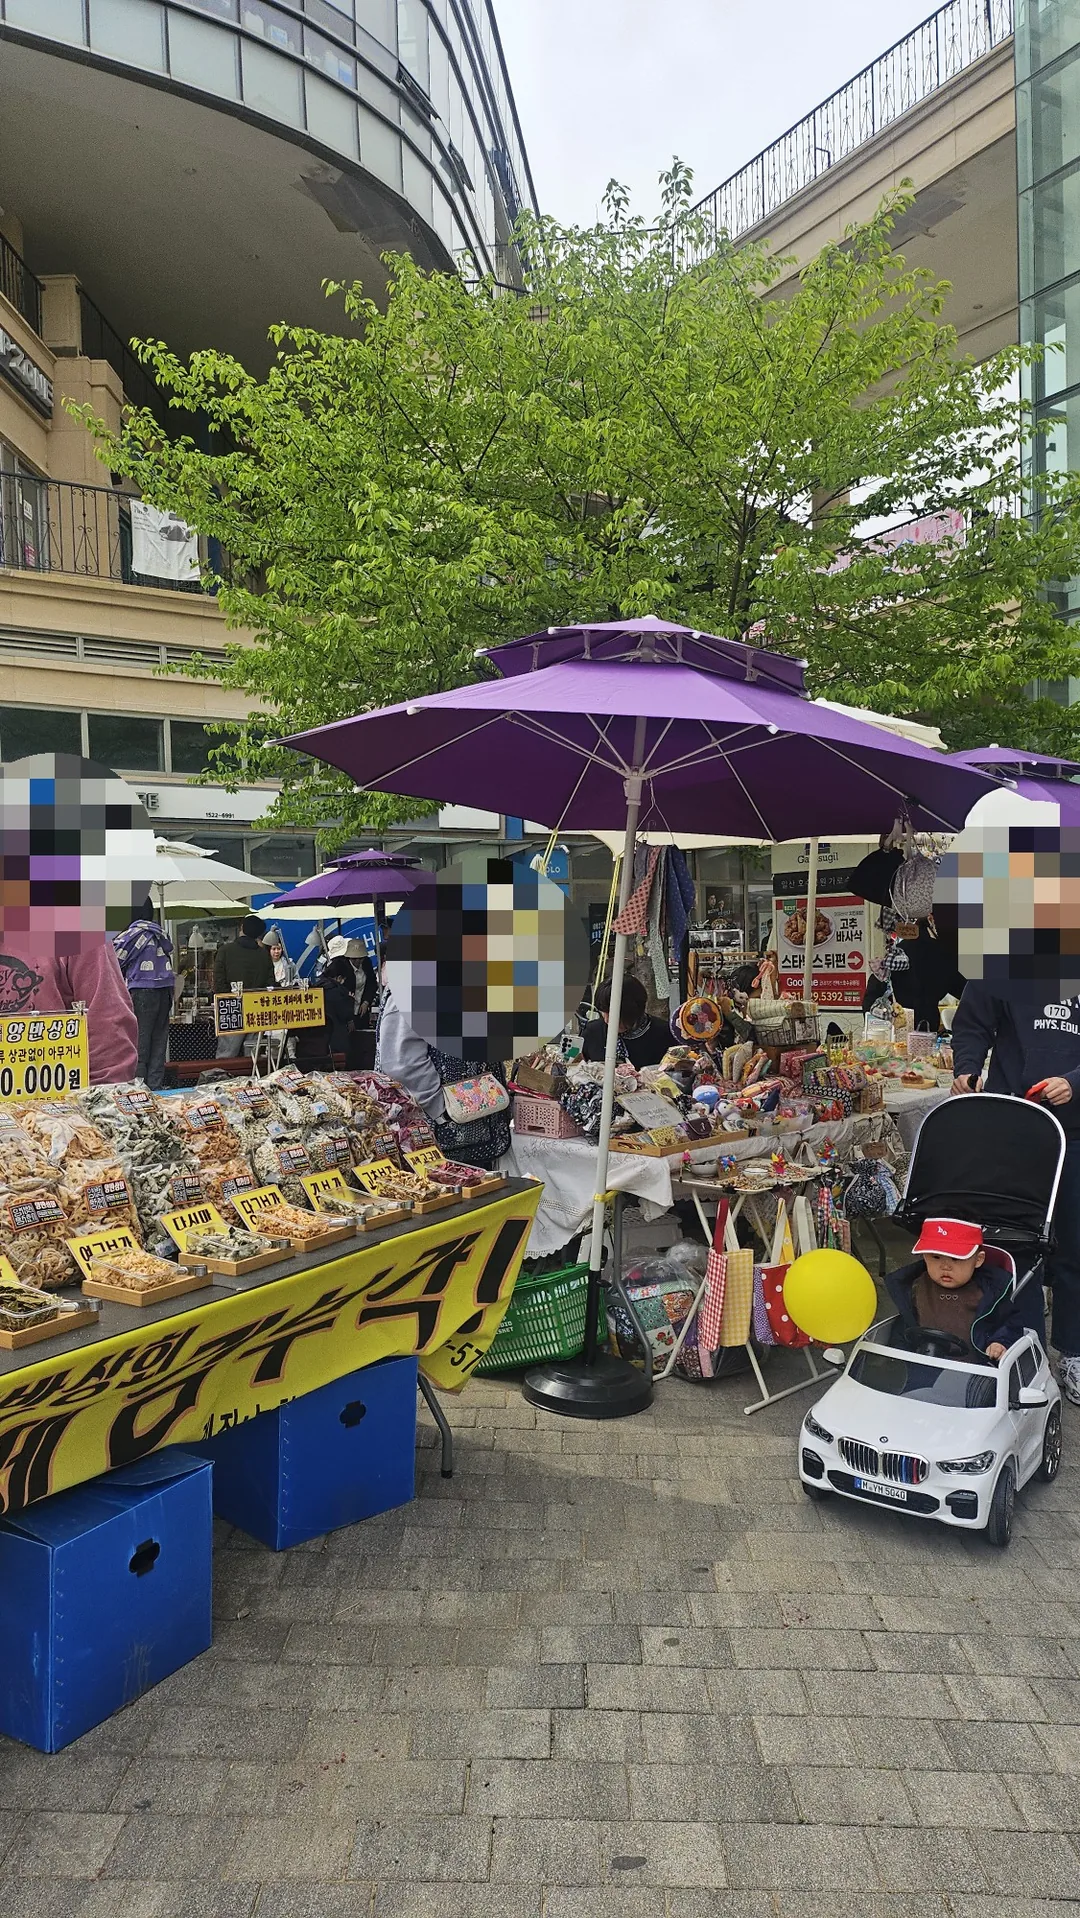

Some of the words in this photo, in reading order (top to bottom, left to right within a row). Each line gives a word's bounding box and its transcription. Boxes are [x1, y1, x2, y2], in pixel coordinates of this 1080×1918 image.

[797, 852, 839, 864] Gasugil
[840, 917, 858, 930] 고추
[836, 930, 863, 942] 바사삭
[786, 977, 819, 987] Gooe
[1048, 1006, 1066, 1018] 170
[7, 1018, 80, 1043] 양반상회
[9, 1047, 45, 1064] 상관없이
[48, 1045, 80, 1060] 아무거나
[172, 1208, 212, 1231] 다시마
